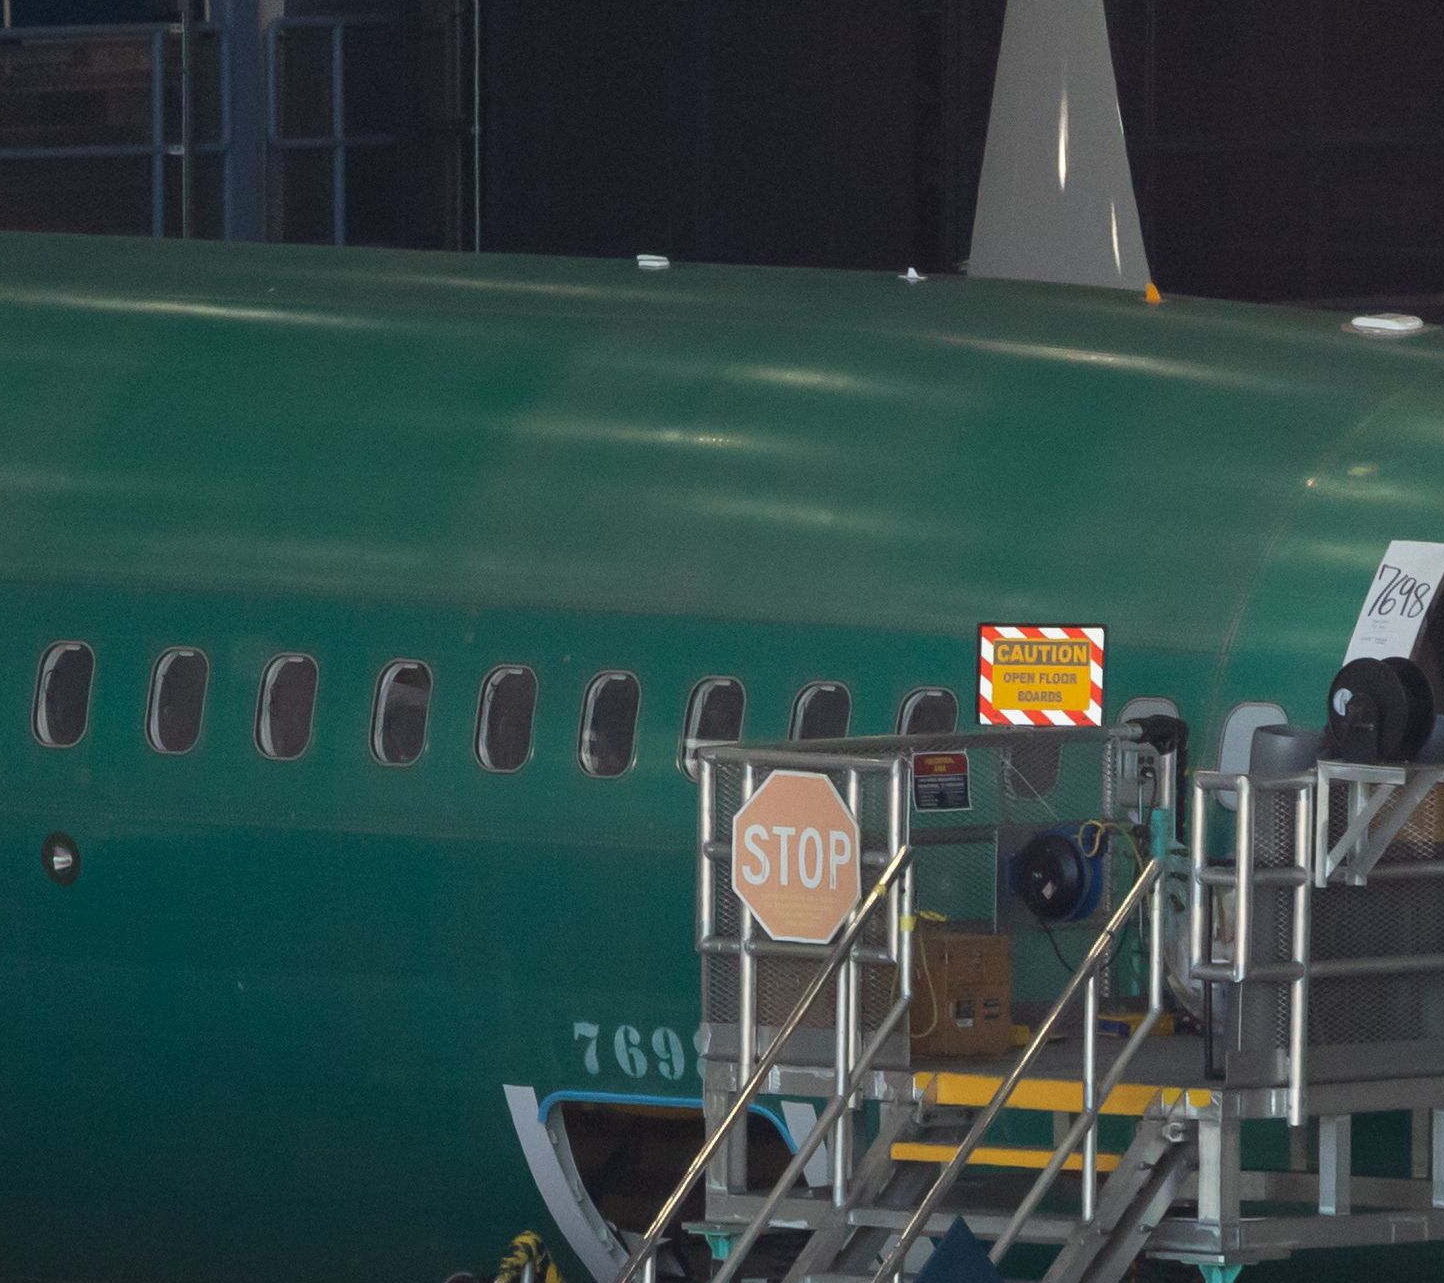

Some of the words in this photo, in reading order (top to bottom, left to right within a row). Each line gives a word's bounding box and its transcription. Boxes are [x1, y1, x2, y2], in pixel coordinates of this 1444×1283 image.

[1368, 564, 1431, 618] 7698
[997, 644, 1088, 663] CAUTION
[1004, 673, 1035, 684] OPEN
[1039, 673, 1078, 684] FLOOR
[1018, 691, 1063, 703] BOARDS
[742, 824, 852, 891] STOP
